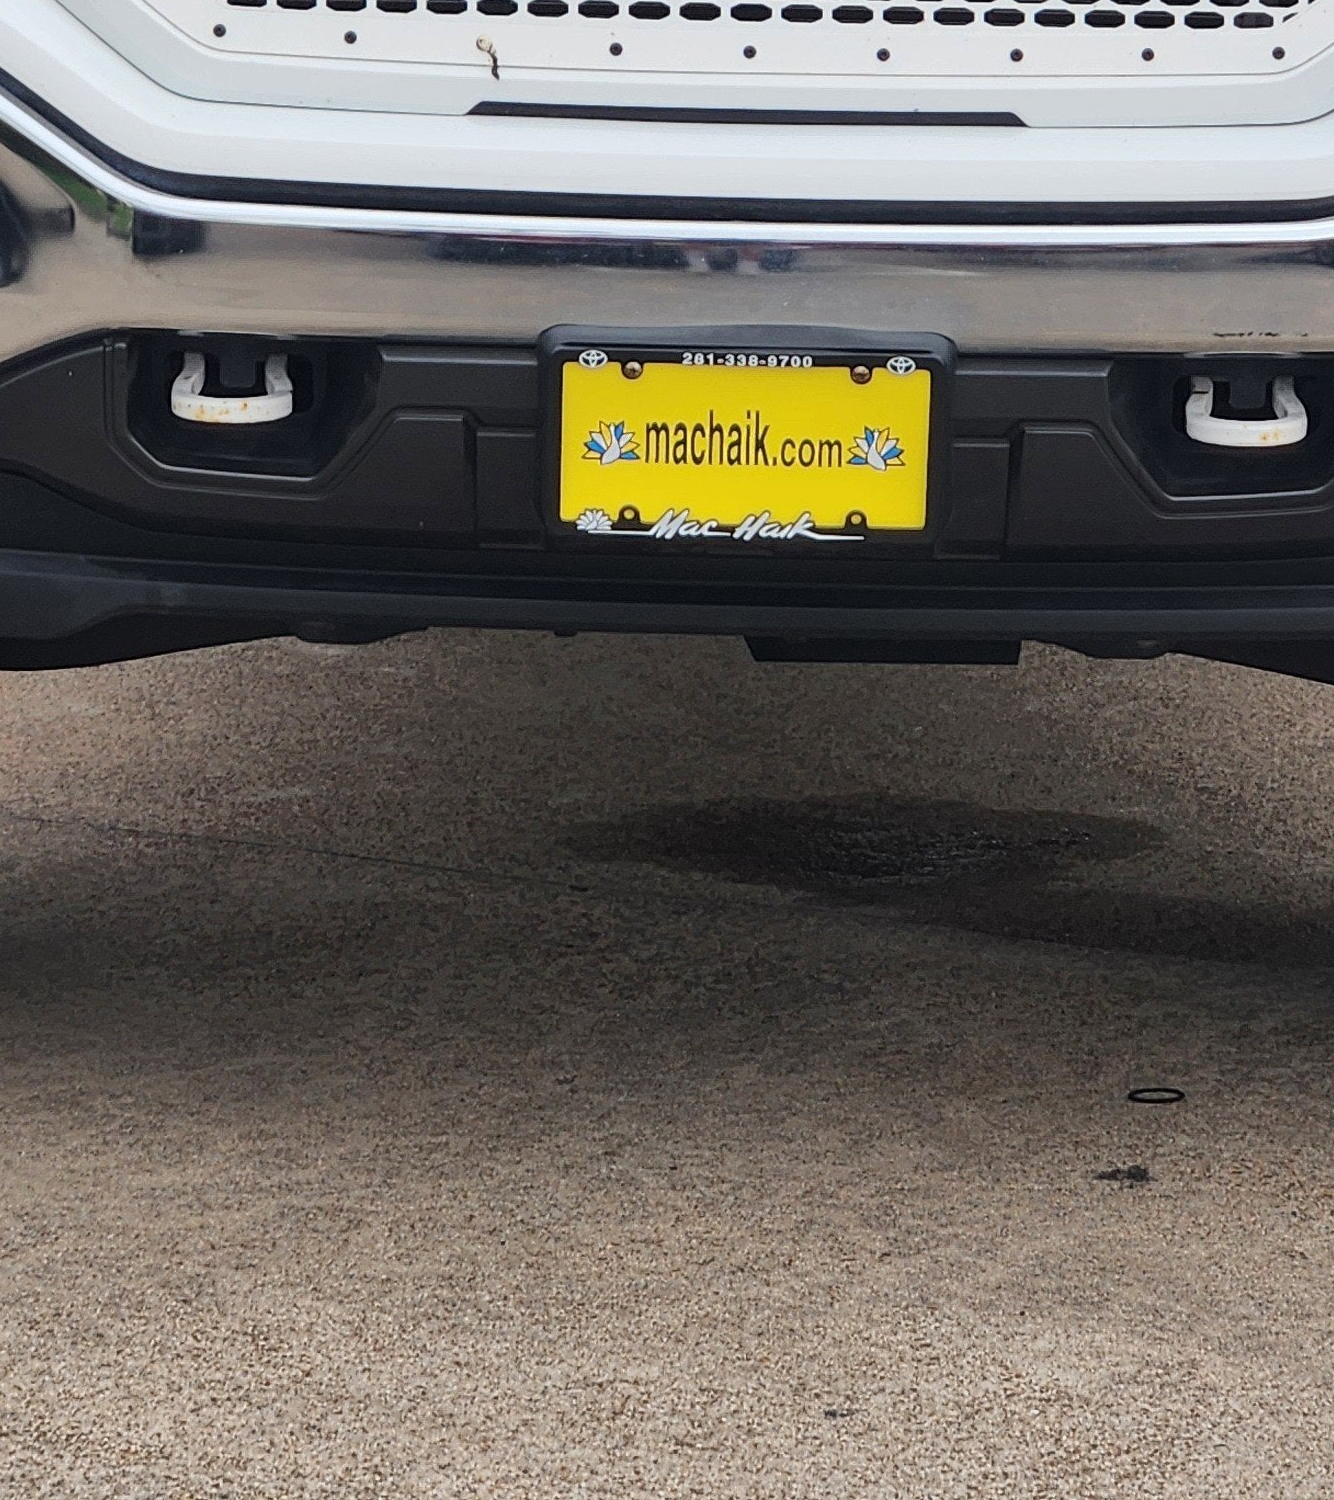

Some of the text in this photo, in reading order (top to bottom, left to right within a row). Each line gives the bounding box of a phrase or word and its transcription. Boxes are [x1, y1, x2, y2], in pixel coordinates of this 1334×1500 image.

[681, 352, 814, 369] 281-338-9700
[644, 408, 844, 468] machaik.com
[650, 508, 817, 541] Mac Haik
